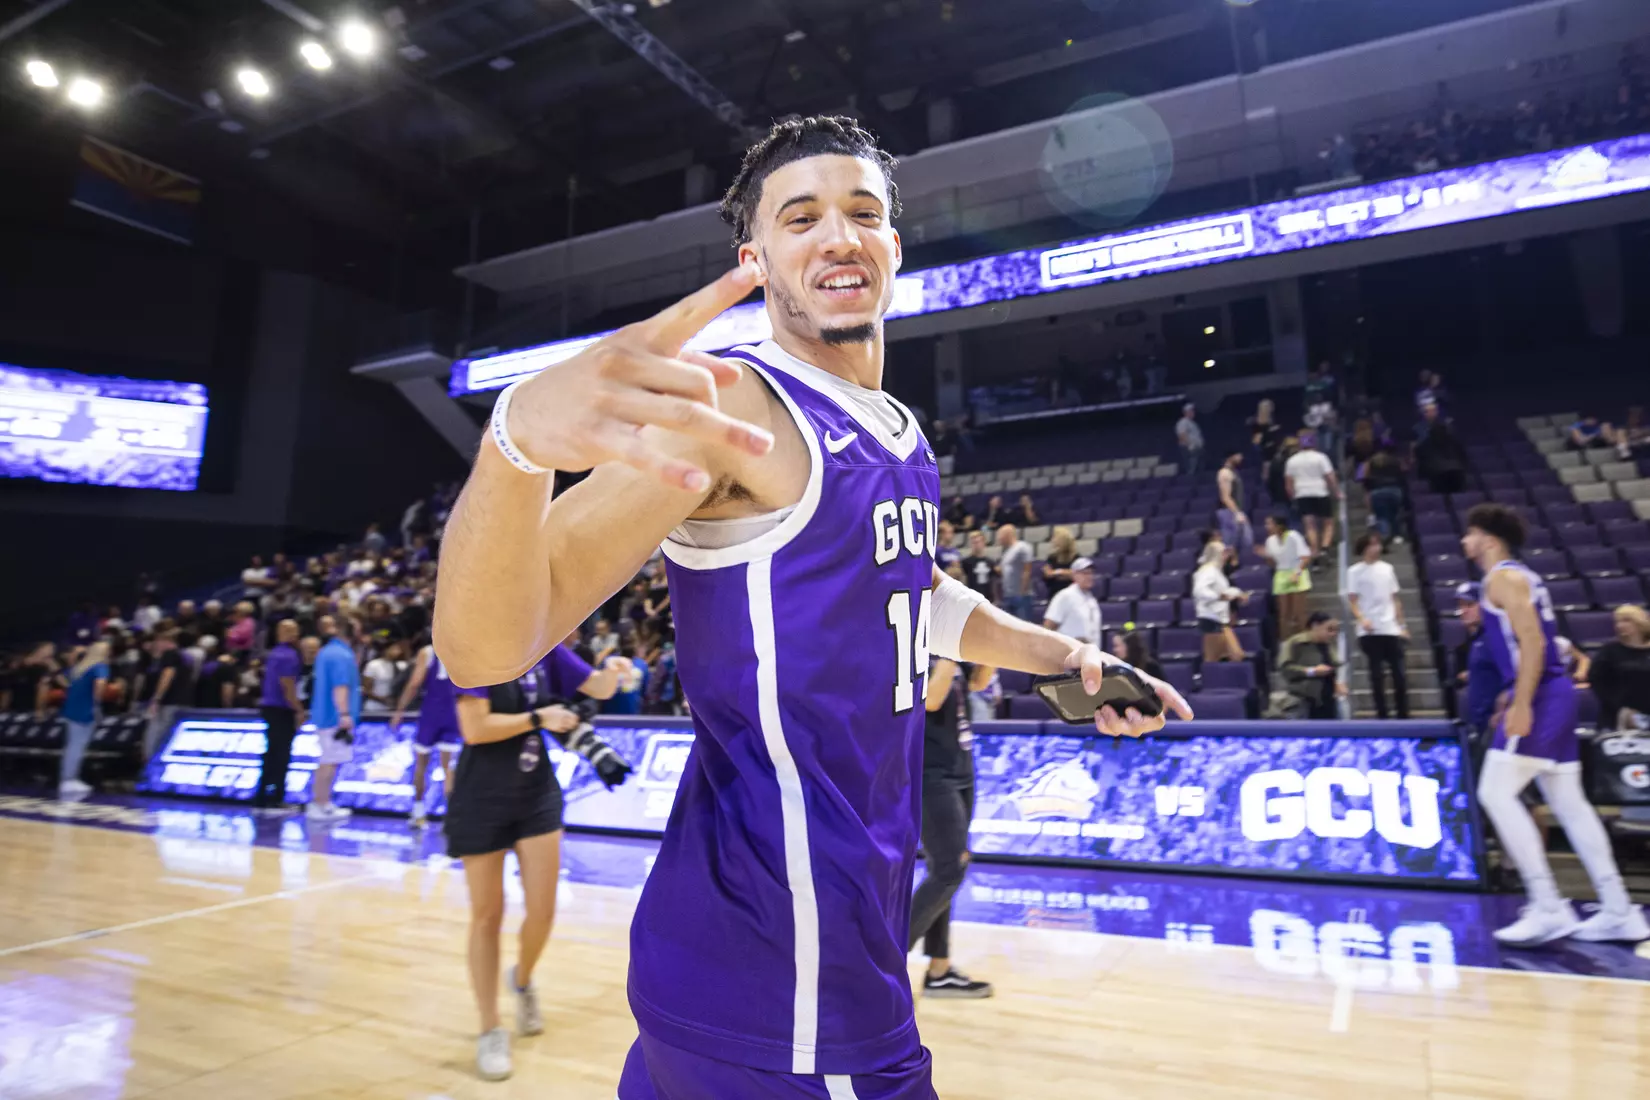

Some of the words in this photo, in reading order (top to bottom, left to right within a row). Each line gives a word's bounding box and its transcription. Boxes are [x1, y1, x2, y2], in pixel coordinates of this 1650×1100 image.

[873, 496, 939, 566] GCU
[885, 586, 932, 717] 14
[1155, 785, 1205, 817] VS
[1240, 766, 1442, 849] GCU
